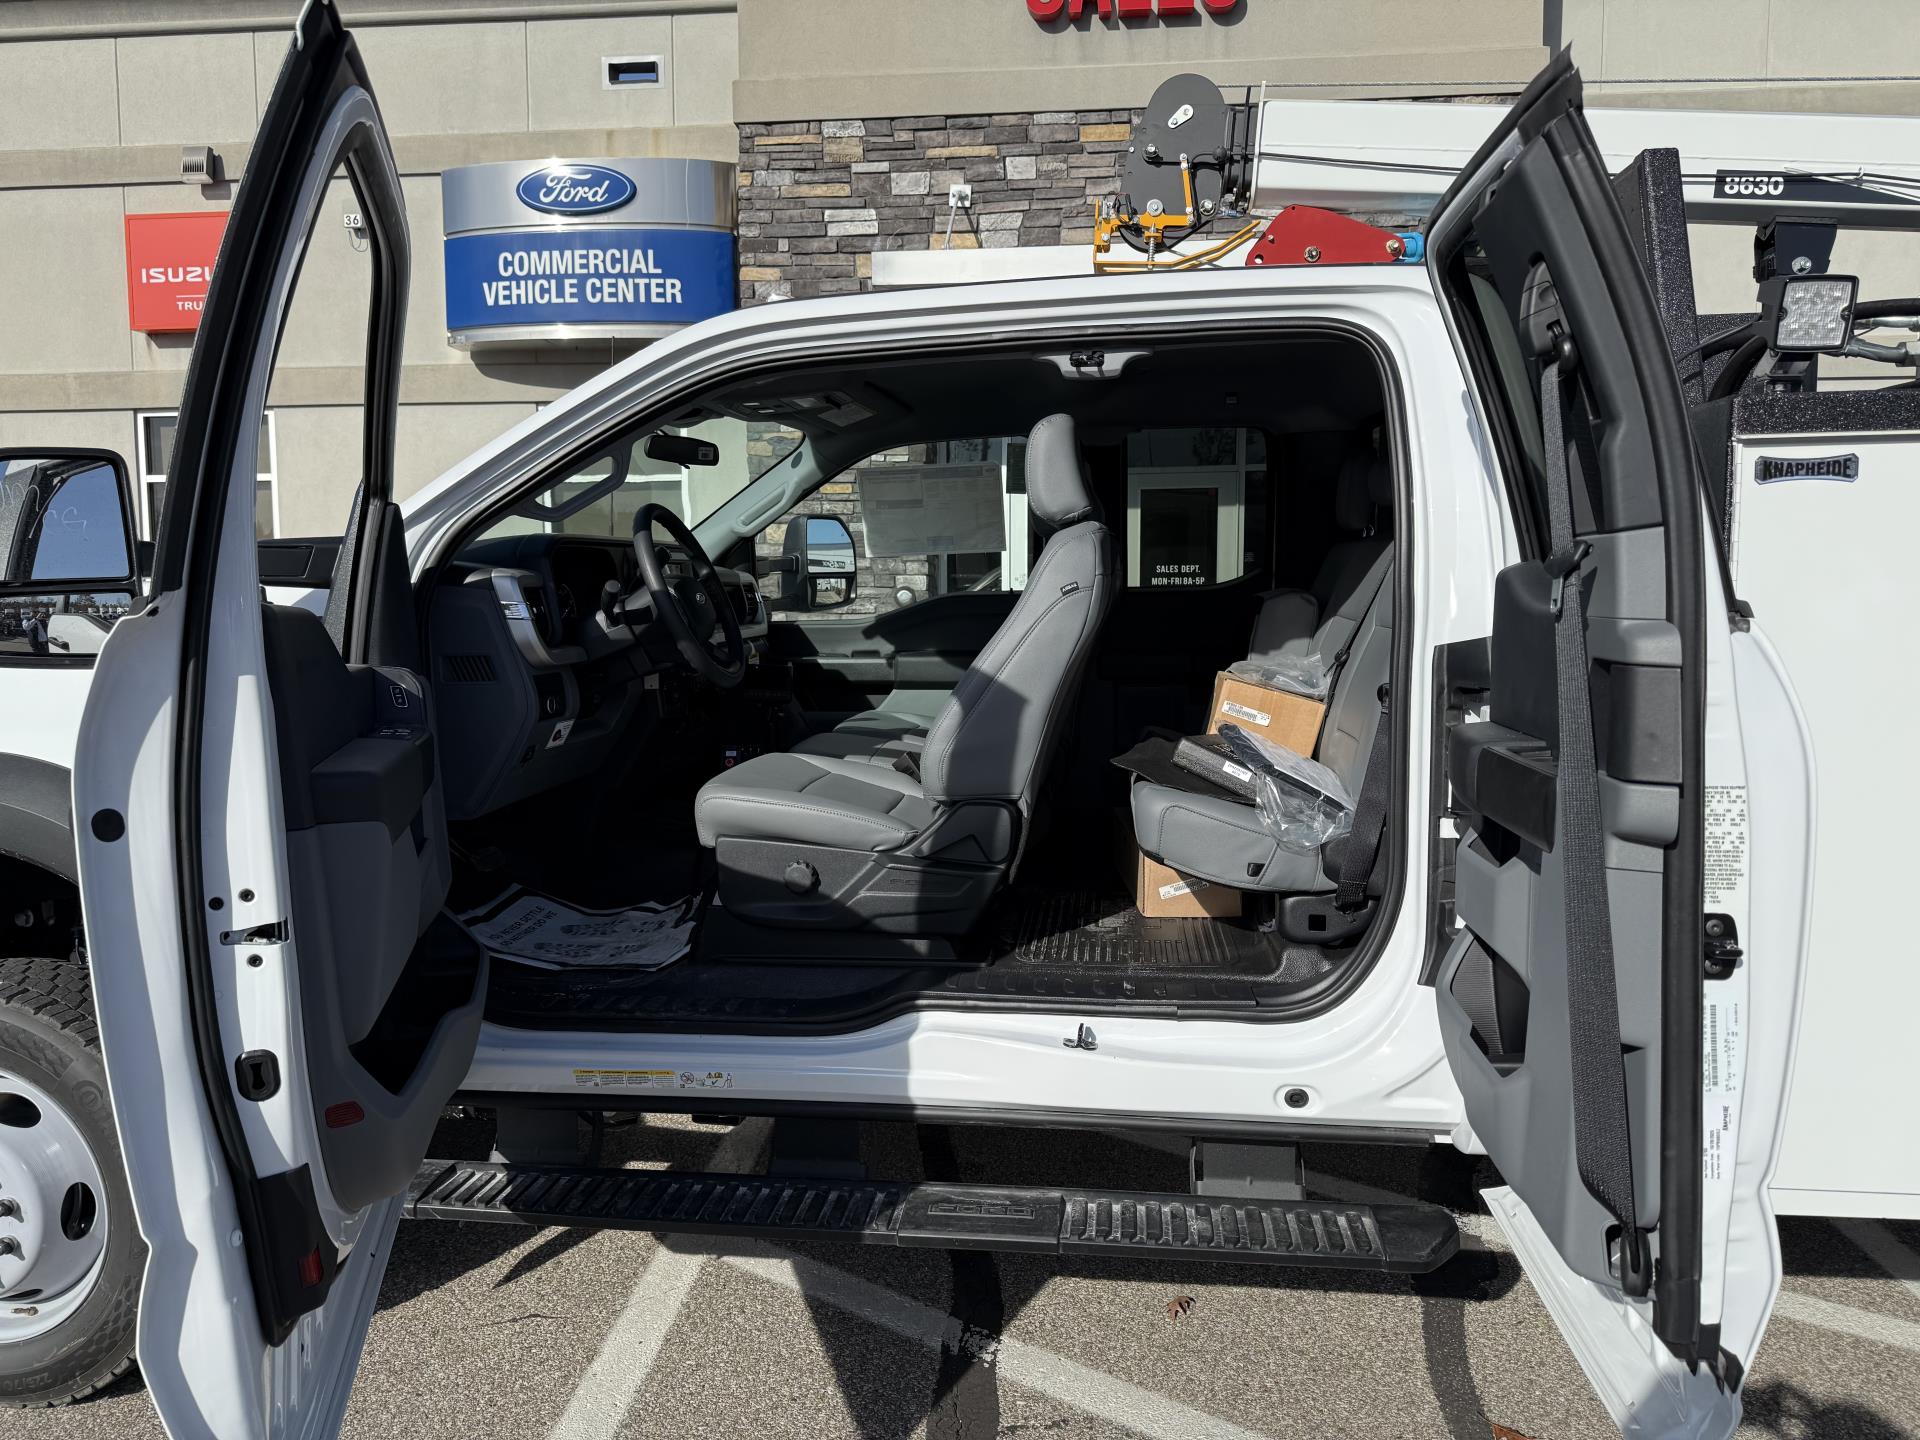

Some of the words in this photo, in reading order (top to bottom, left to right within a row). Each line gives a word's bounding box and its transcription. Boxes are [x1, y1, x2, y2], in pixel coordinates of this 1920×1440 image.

[539, 173, 610, 203] Ford
[1724, 176, 1784, 195] 8630
[345, 215, 359, 225] 36
[499, 248, 662, 276] COMMERCIAL
[483, 279, 579, 306] VEHICLE
[586, 278, 682, 304] CENTER
[1763, 458, 1852, 480] KNAPHEIDE
[1156, 564, 1179, 573] SALES
[1181, 564, 1201, 573] DEPT.
[1151, 577, 1182, 586] MON-FRI
